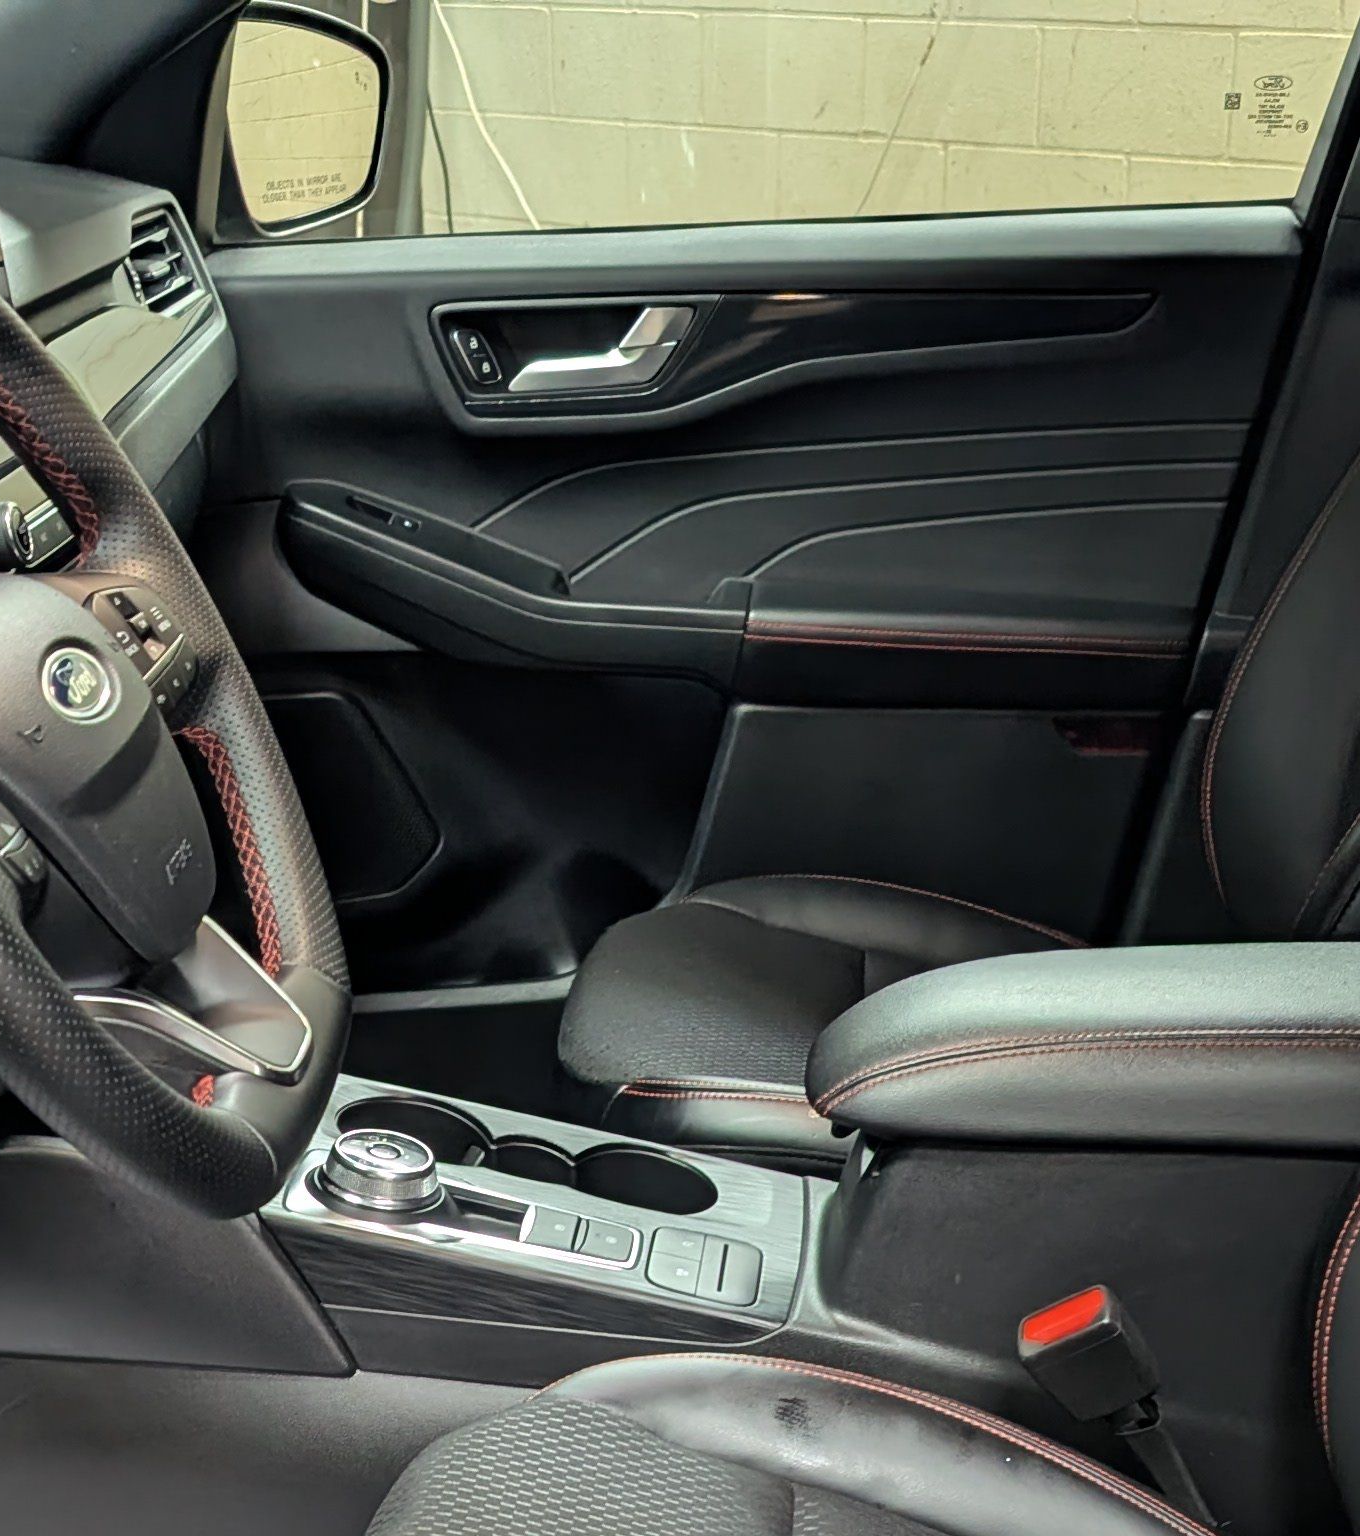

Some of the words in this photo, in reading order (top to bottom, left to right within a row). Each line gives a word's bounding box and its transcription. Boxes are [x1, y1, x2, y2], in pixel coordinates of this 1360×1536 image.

[265, 178, 294, 191] OBJECTS
[297, 177, 304, 186] IN
[306, 174, 328, 186] MIRROR
[324, 183, 347, 195] APPEAR
